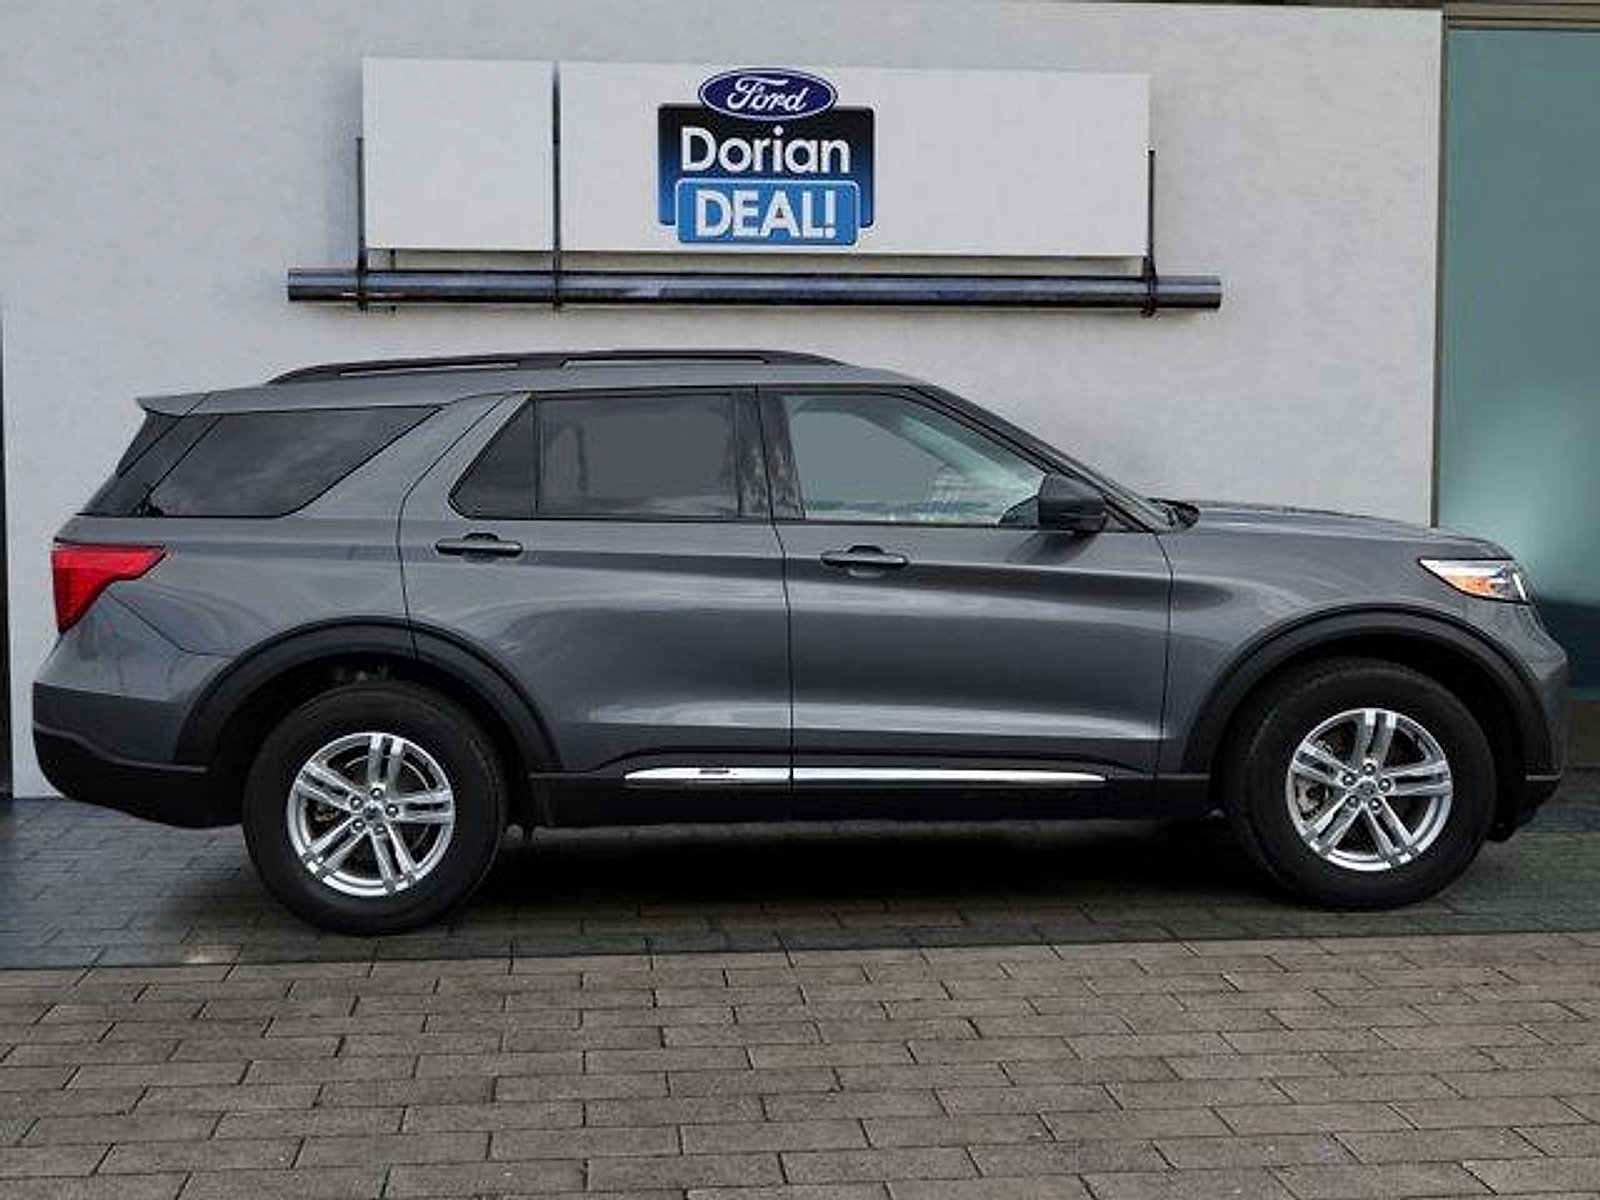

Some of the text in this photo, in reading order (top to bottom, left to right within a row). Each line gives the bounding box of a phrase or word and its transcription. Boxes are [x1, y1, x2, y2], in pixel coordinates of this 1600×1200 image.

[727, 76, 809, 111] Ford
[681, 125, 849, 173] Dorian
[695, 189, 836, 238] DEAL!
